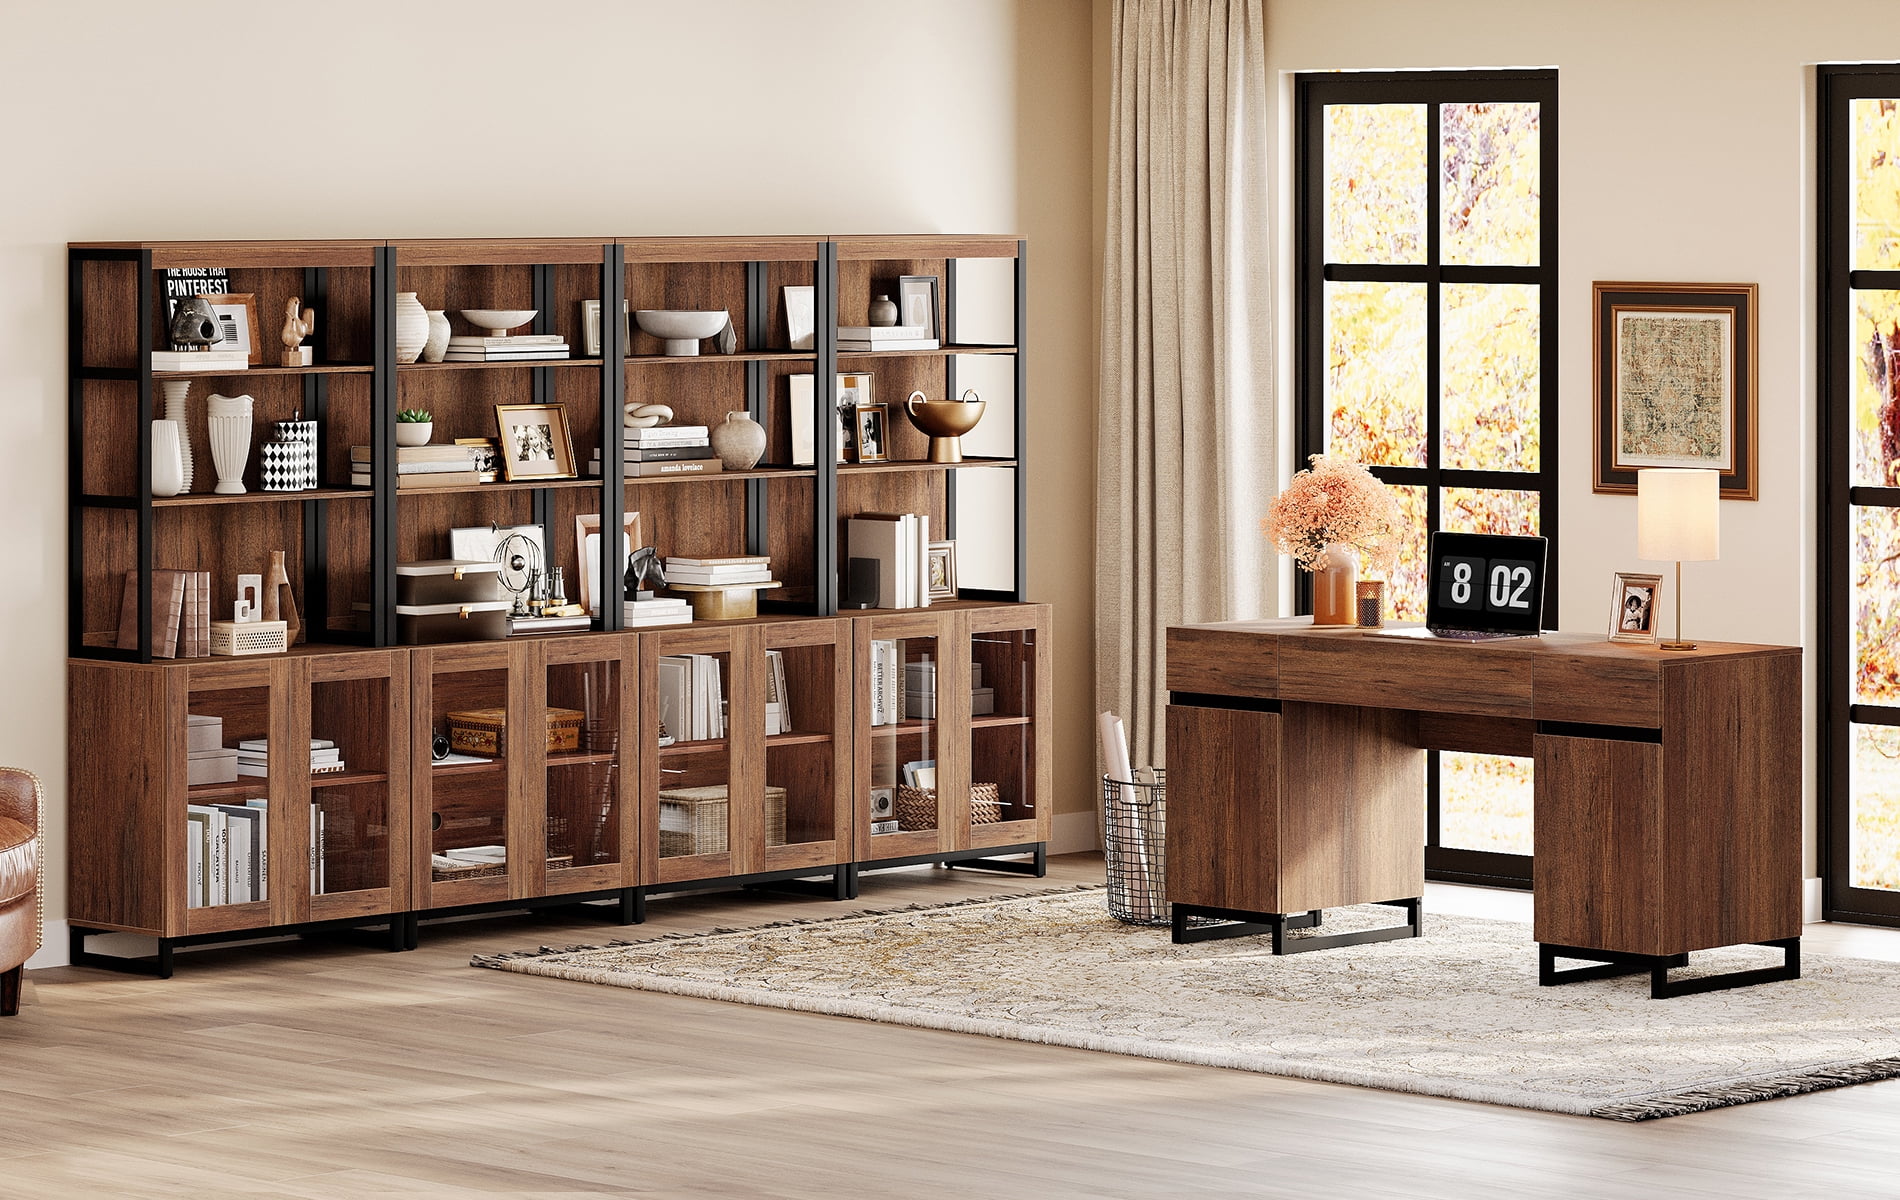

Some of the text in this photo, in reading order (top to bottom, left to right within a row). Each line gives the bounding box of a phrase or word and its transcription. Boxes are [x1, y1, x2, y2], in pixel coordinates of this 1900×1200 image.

[167, 268, 226, 277] THE HOUSE THAT
[167, 279, 228, 297] PINTEREST
[661, 463, 704, 472] amanda lovelace
[1451, 562, 1532, 608] 8 02
